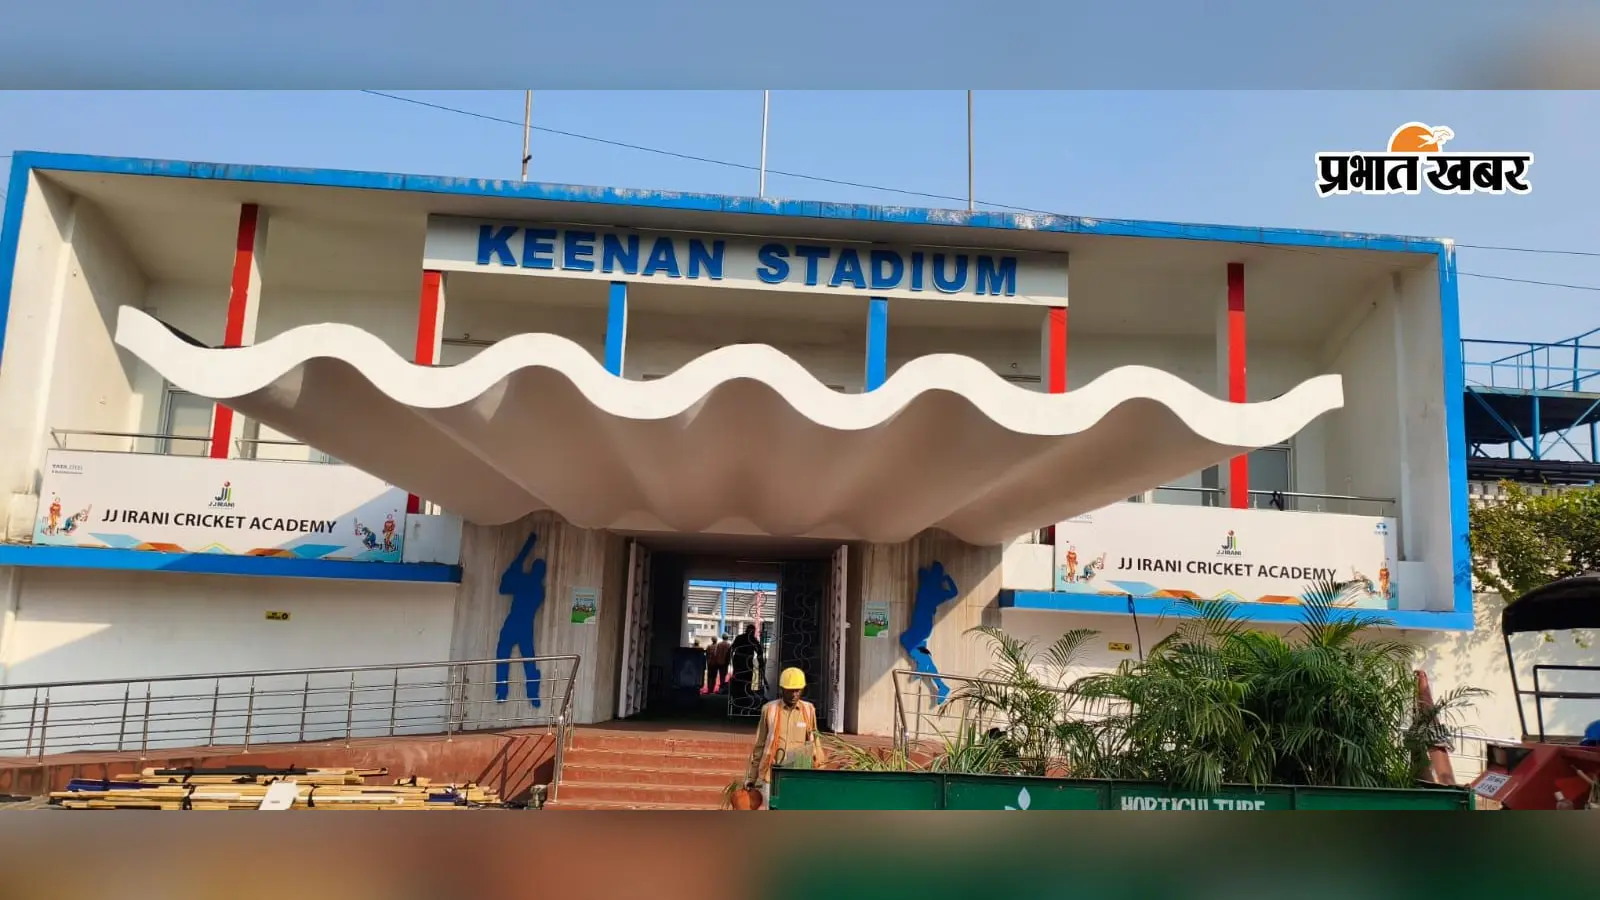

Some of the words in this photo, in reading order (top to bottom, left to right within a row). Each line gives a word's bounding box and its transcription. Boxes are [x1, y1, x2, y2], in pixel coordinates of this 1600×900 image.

[476, 224, 726, 280] KEENAN
[757, 244, 1018, 297] STADIUM
[102, 508, 118, 522] JJ
[122, 509, 170, 526] IRANI
[174, 512, 247, 530] CRICKET
[249, 516, 338, 534] ACADEMY
[1118, 557, 1133, 570] JJ
[1137, 557, 1182, 573] IRANI
[1186, 560, 1254, 577] CRICKET
[1257, 564, 1337, 581] ACADEMY
